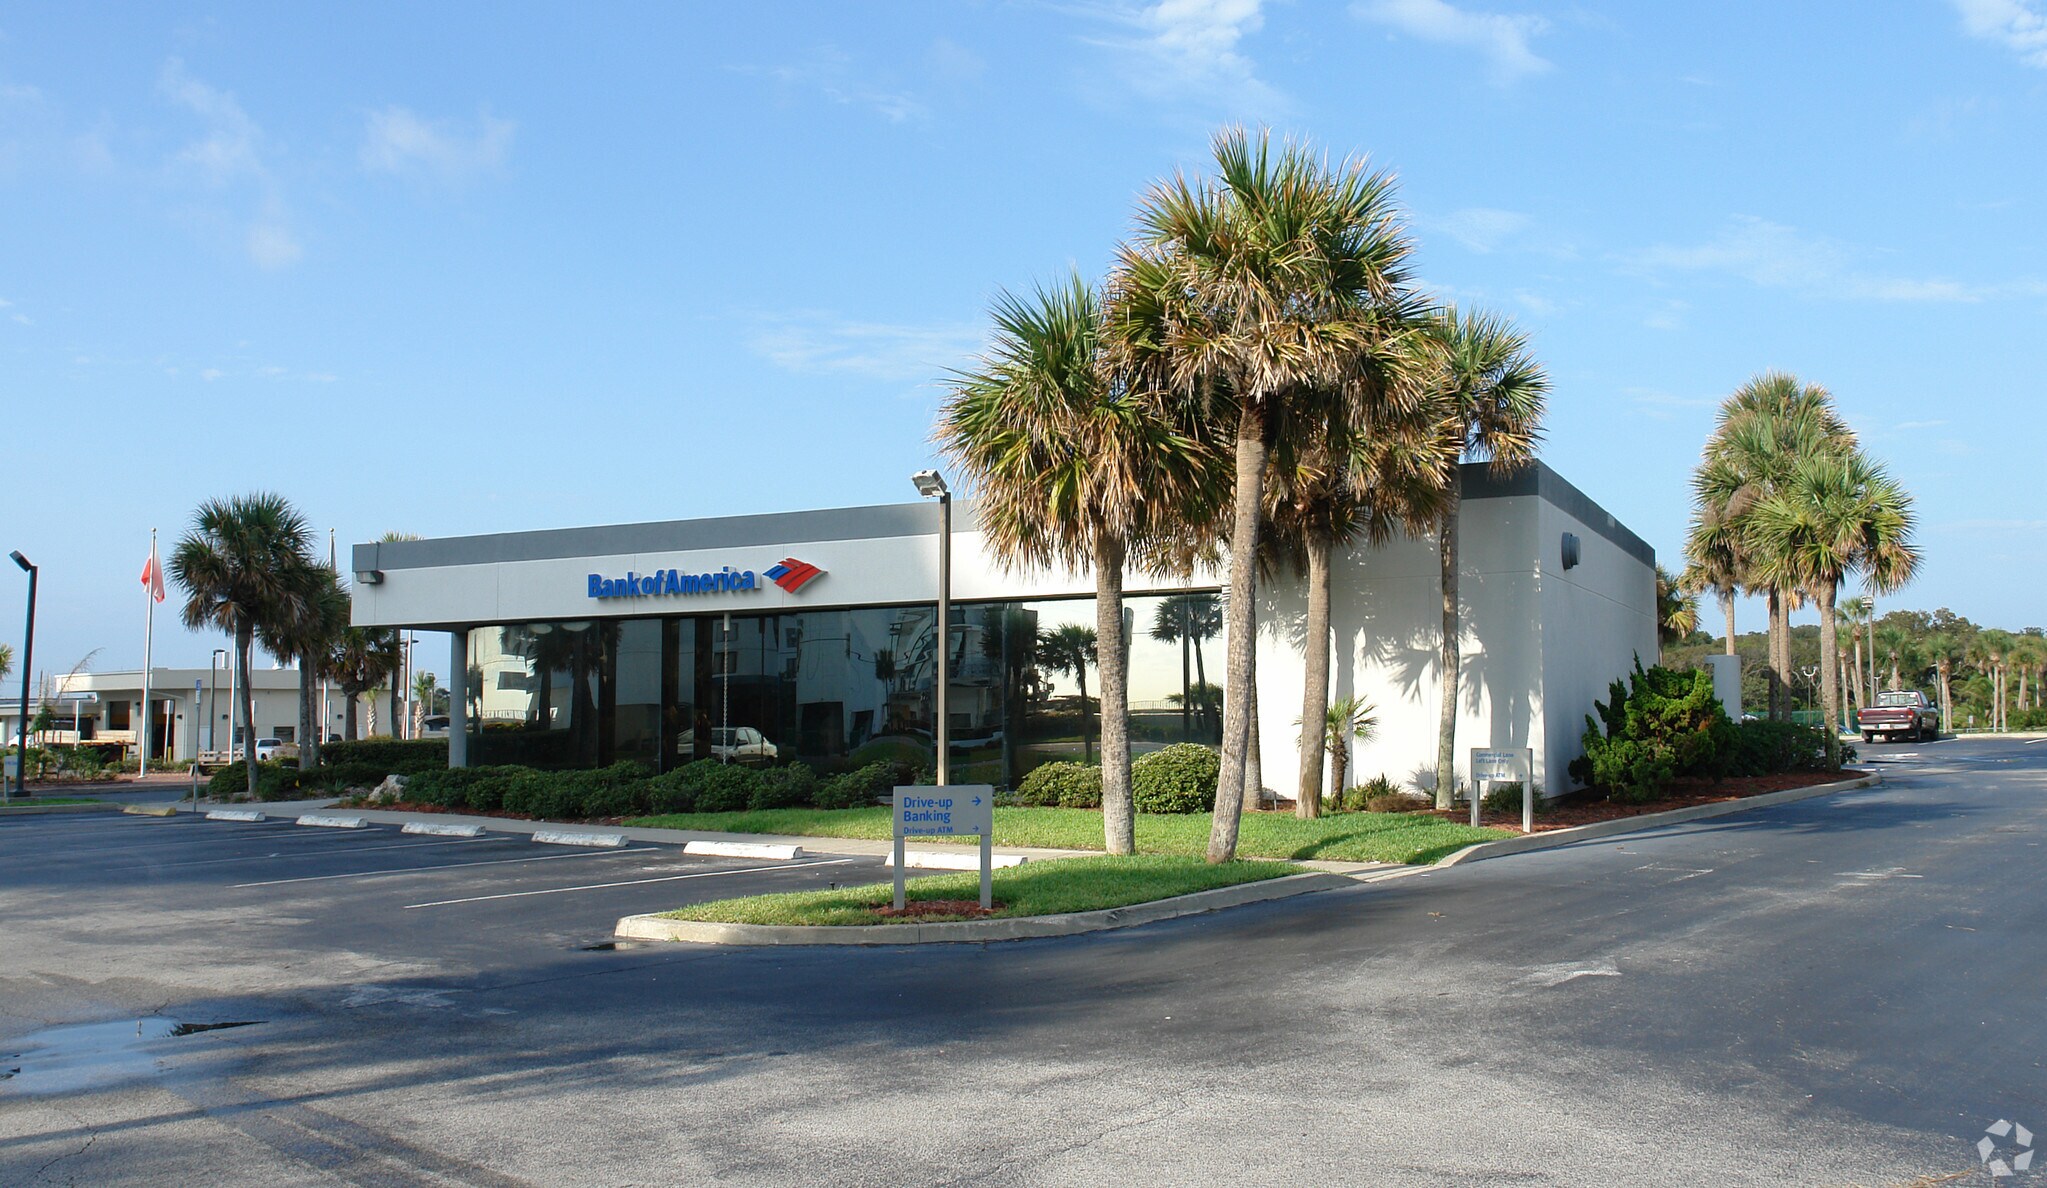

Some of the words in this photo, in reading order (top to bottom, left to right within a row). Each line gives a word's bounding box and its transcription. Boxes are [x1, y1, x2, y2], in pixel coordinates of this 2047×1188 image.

[588, 572, 641, 598] Bank
[641, 570, 664, 595] of
[664, 566, 755, 594] America
[903, 796, 953, 810] Drive-up
[903, 810, 951, 824] Banking
[903, 826, 936, 836] Drive-up
[937, 826, 954, 834] ATM
